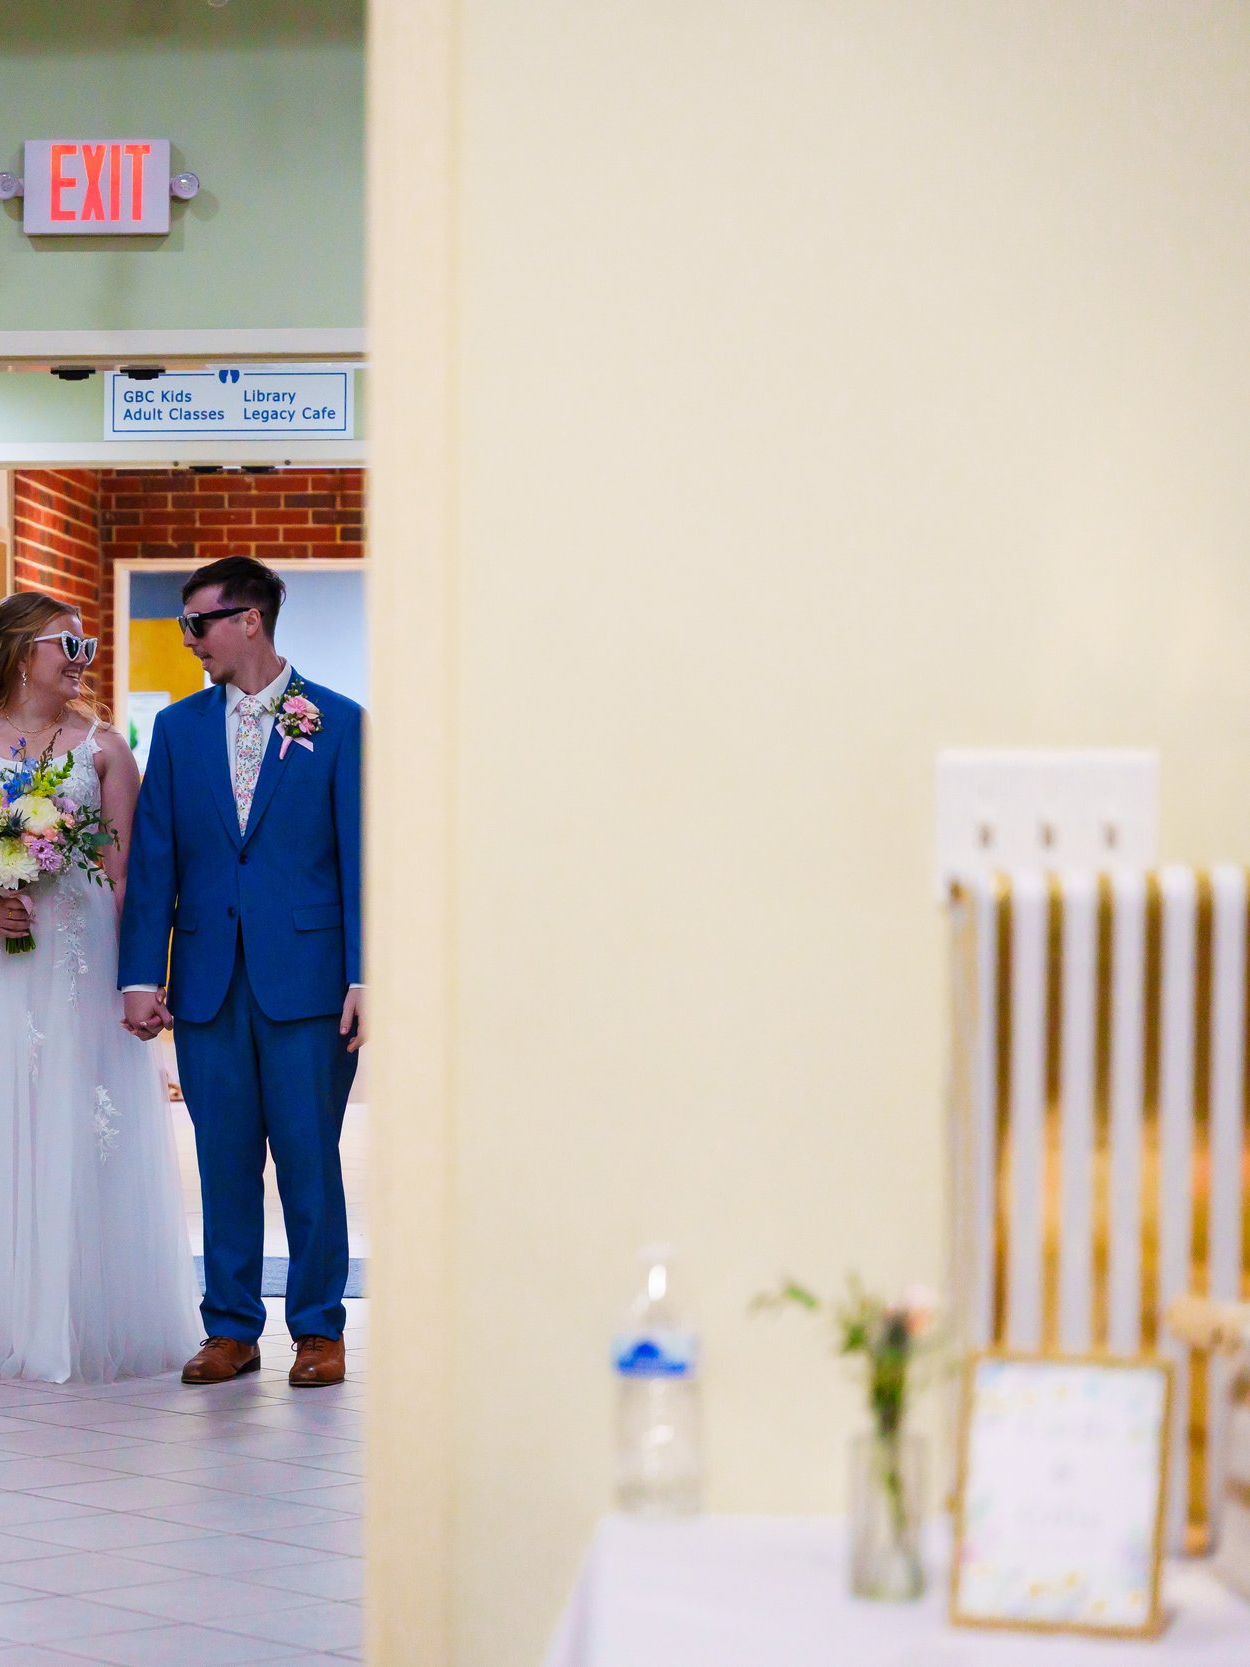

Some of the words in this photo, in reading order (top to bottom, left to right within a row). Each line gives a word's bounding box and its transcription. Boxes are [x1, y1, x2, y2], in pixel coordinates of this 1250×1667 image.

[49, 143, 152, 222] EXIT
[123, 390, 155, 403] GBC
[161, 389, 192, 403] Kids
[243, 389, 296, 405] Library
[123, 408, 163, 421] Adult
[168, 407, 225, 421] Classes
[243, 407, 296, 423] Legacy
[301, 406, 336, 420] Cafe
